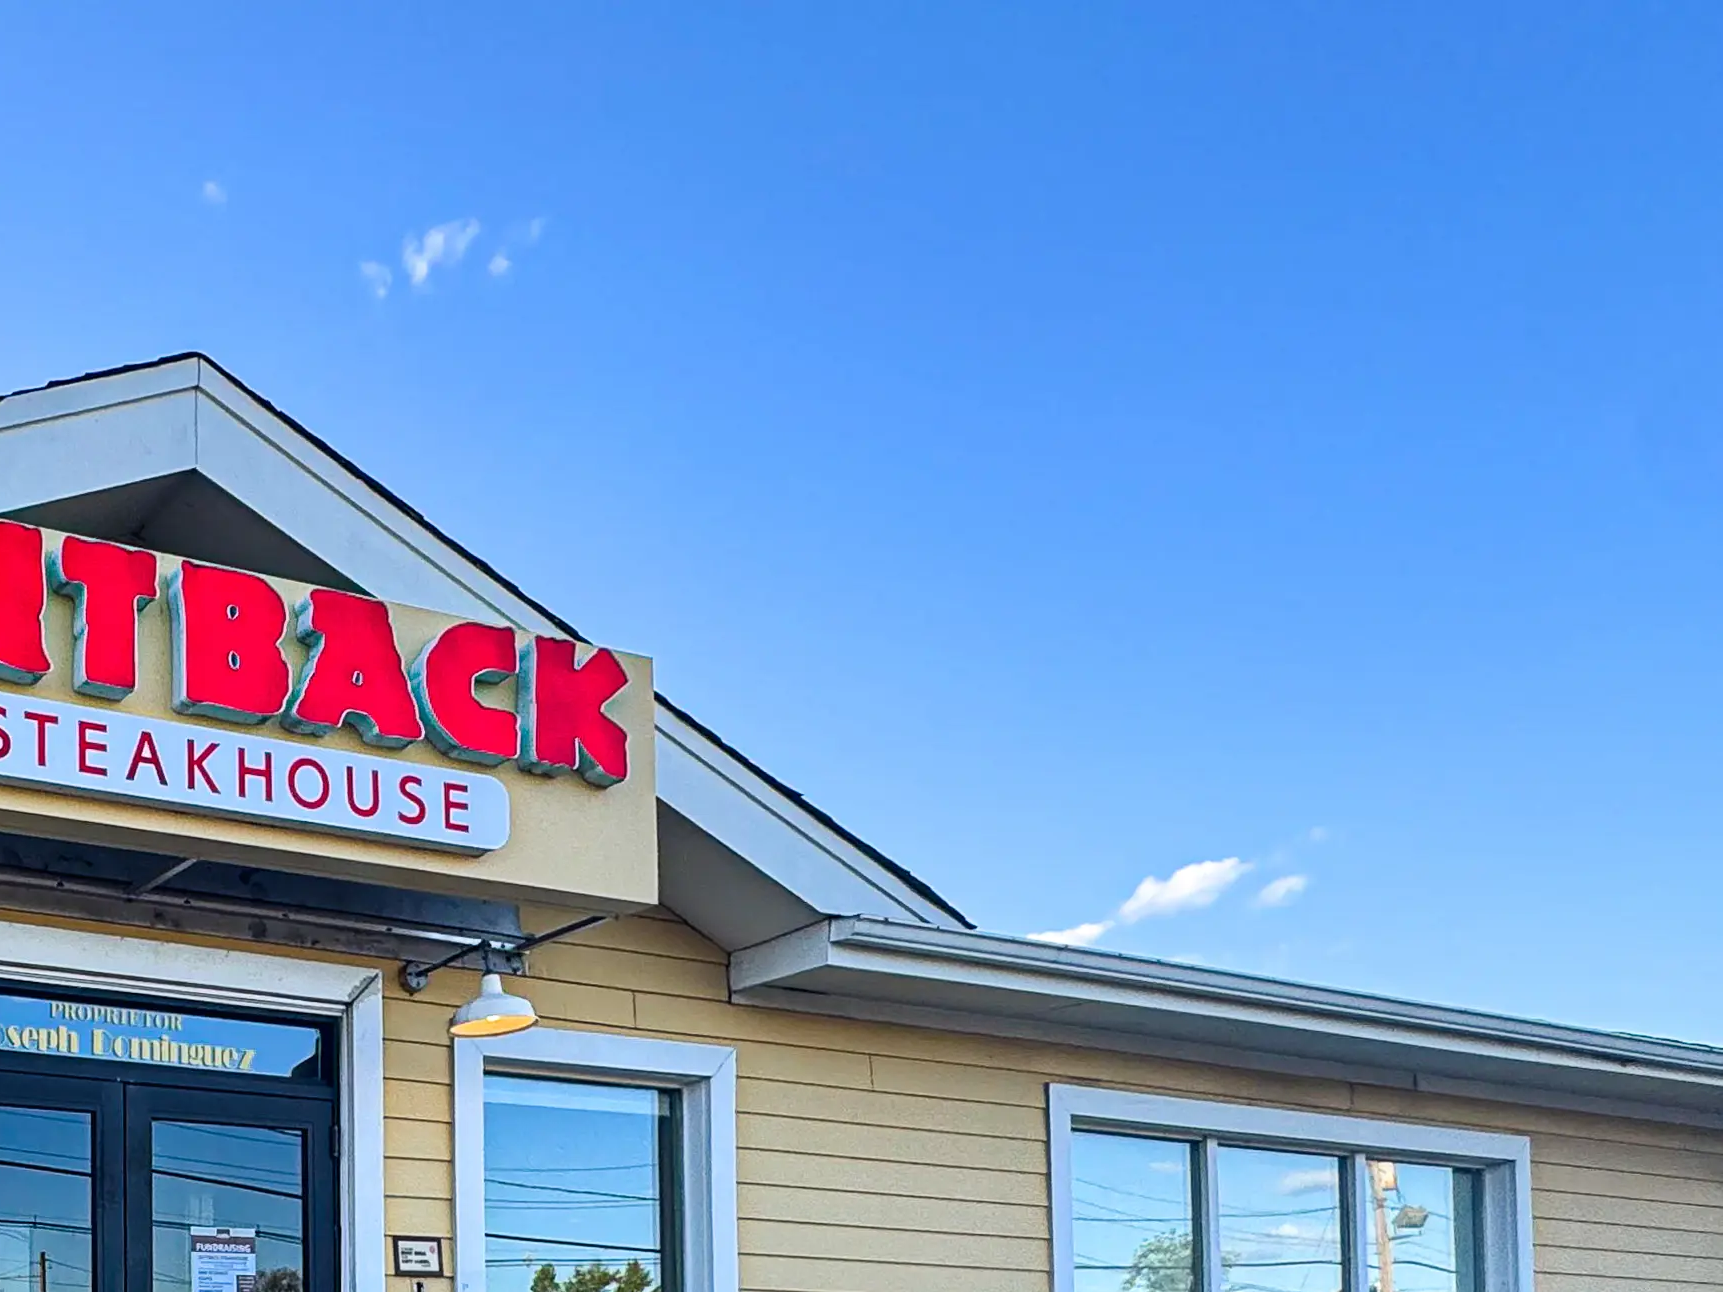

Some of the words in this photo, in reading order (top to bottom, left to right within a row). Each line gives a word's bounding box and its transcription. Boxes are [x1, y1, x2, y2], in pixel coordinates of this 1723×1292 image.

[50, 1002, 183, 1031] PROPRIETOR
[91, 1028, 256, 1071] Dominguez
[196, 1242, 251, 1253] FUNDRAISING
